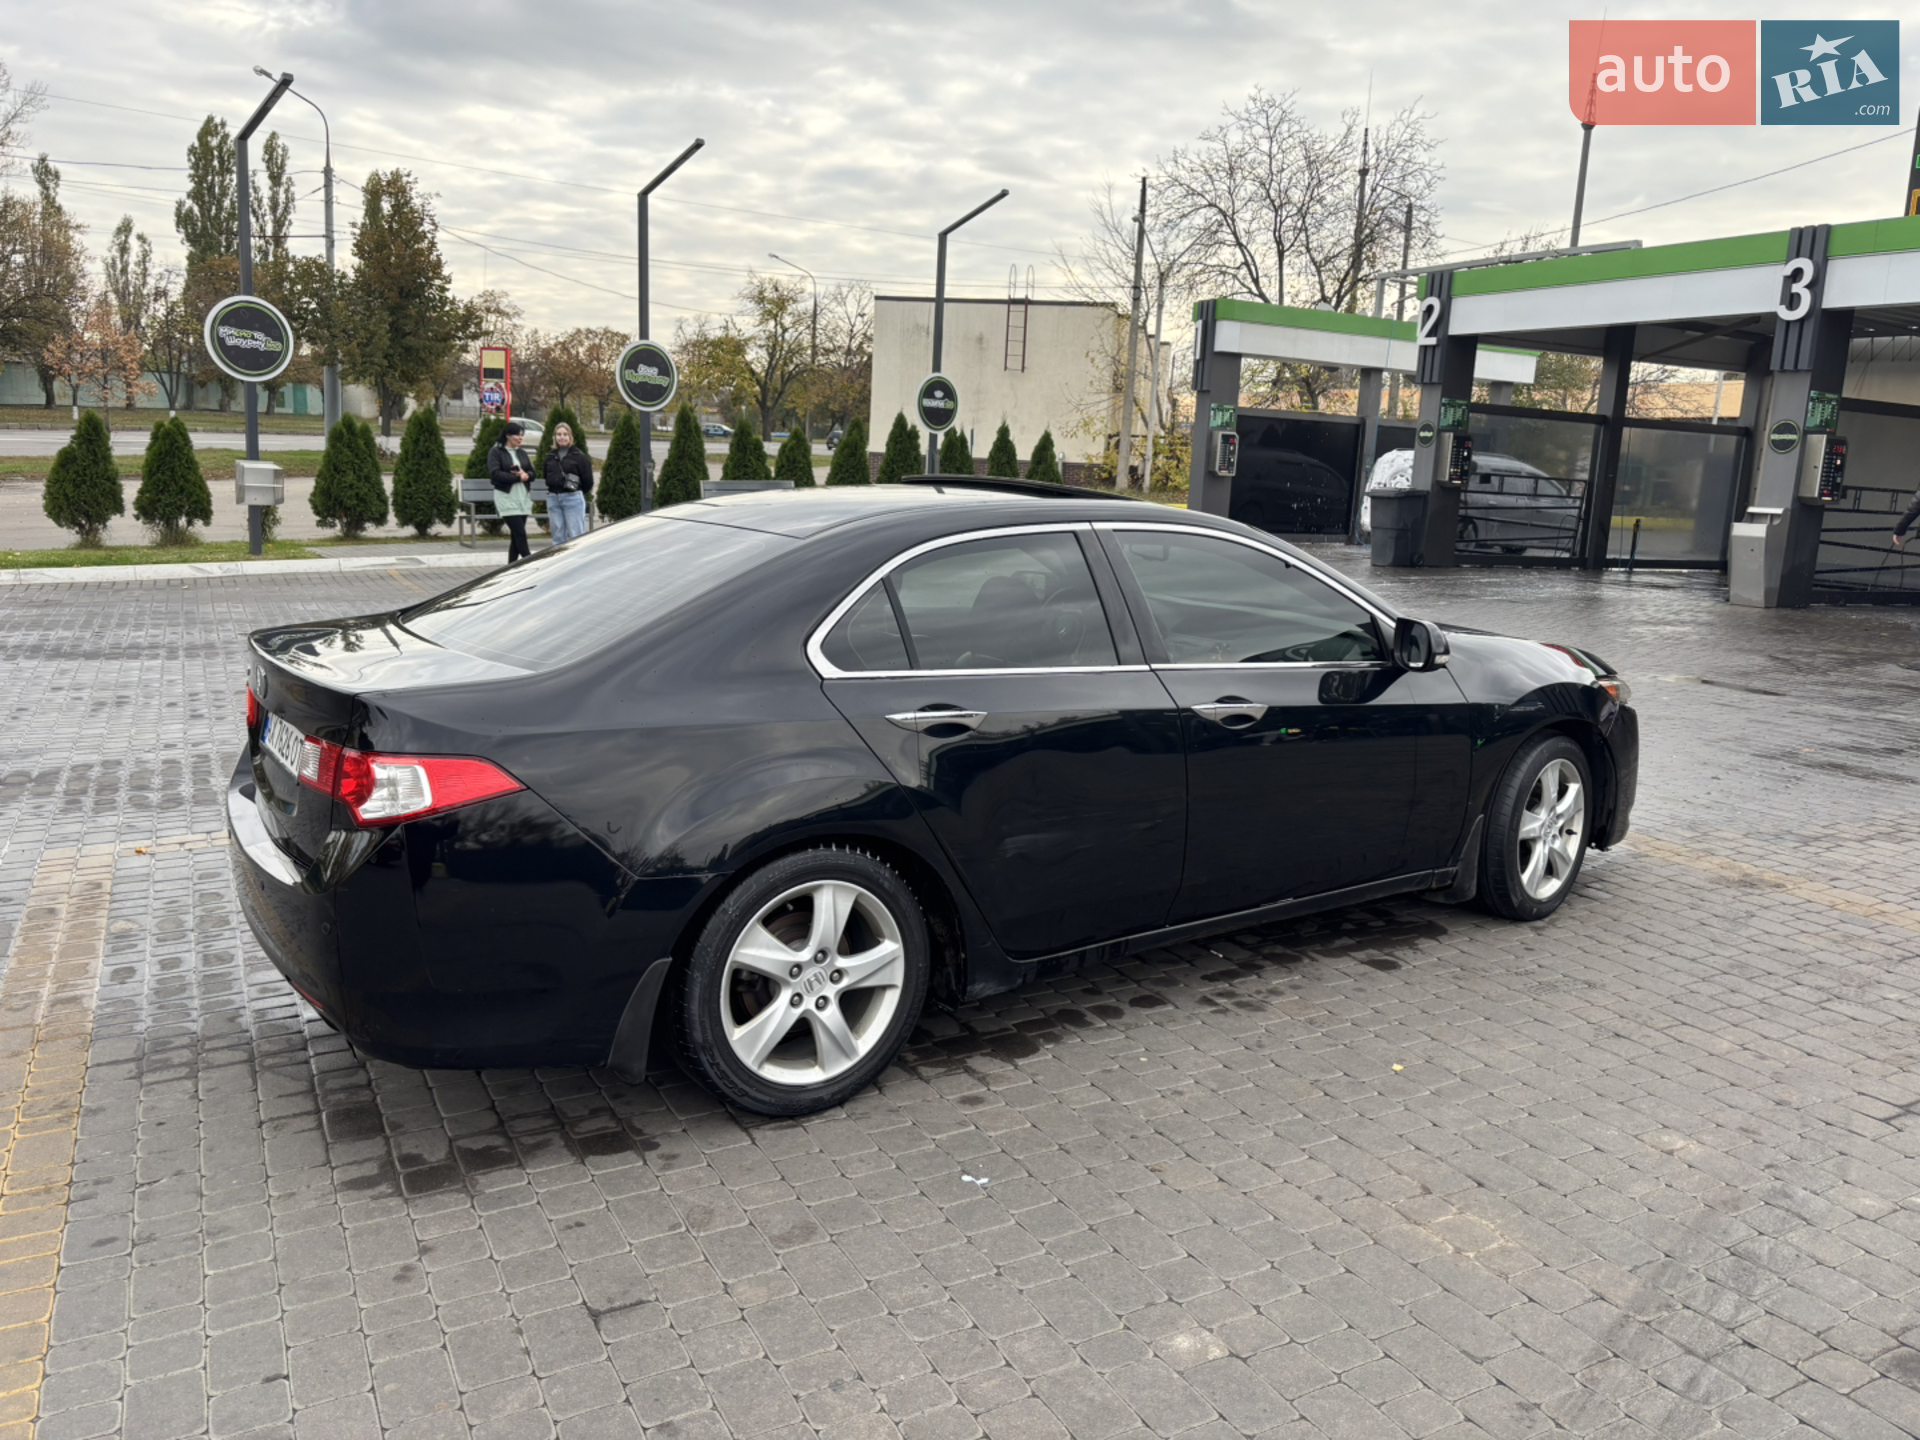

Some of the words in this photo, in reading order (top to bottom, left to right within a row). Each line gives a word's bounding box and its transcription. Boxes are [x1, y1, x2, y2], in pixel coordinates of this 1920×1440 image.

[1777, 257, 1814, 321] 3
[1417, 296, 1441, 346] 2
[484, 392, 501, 403] TIR
